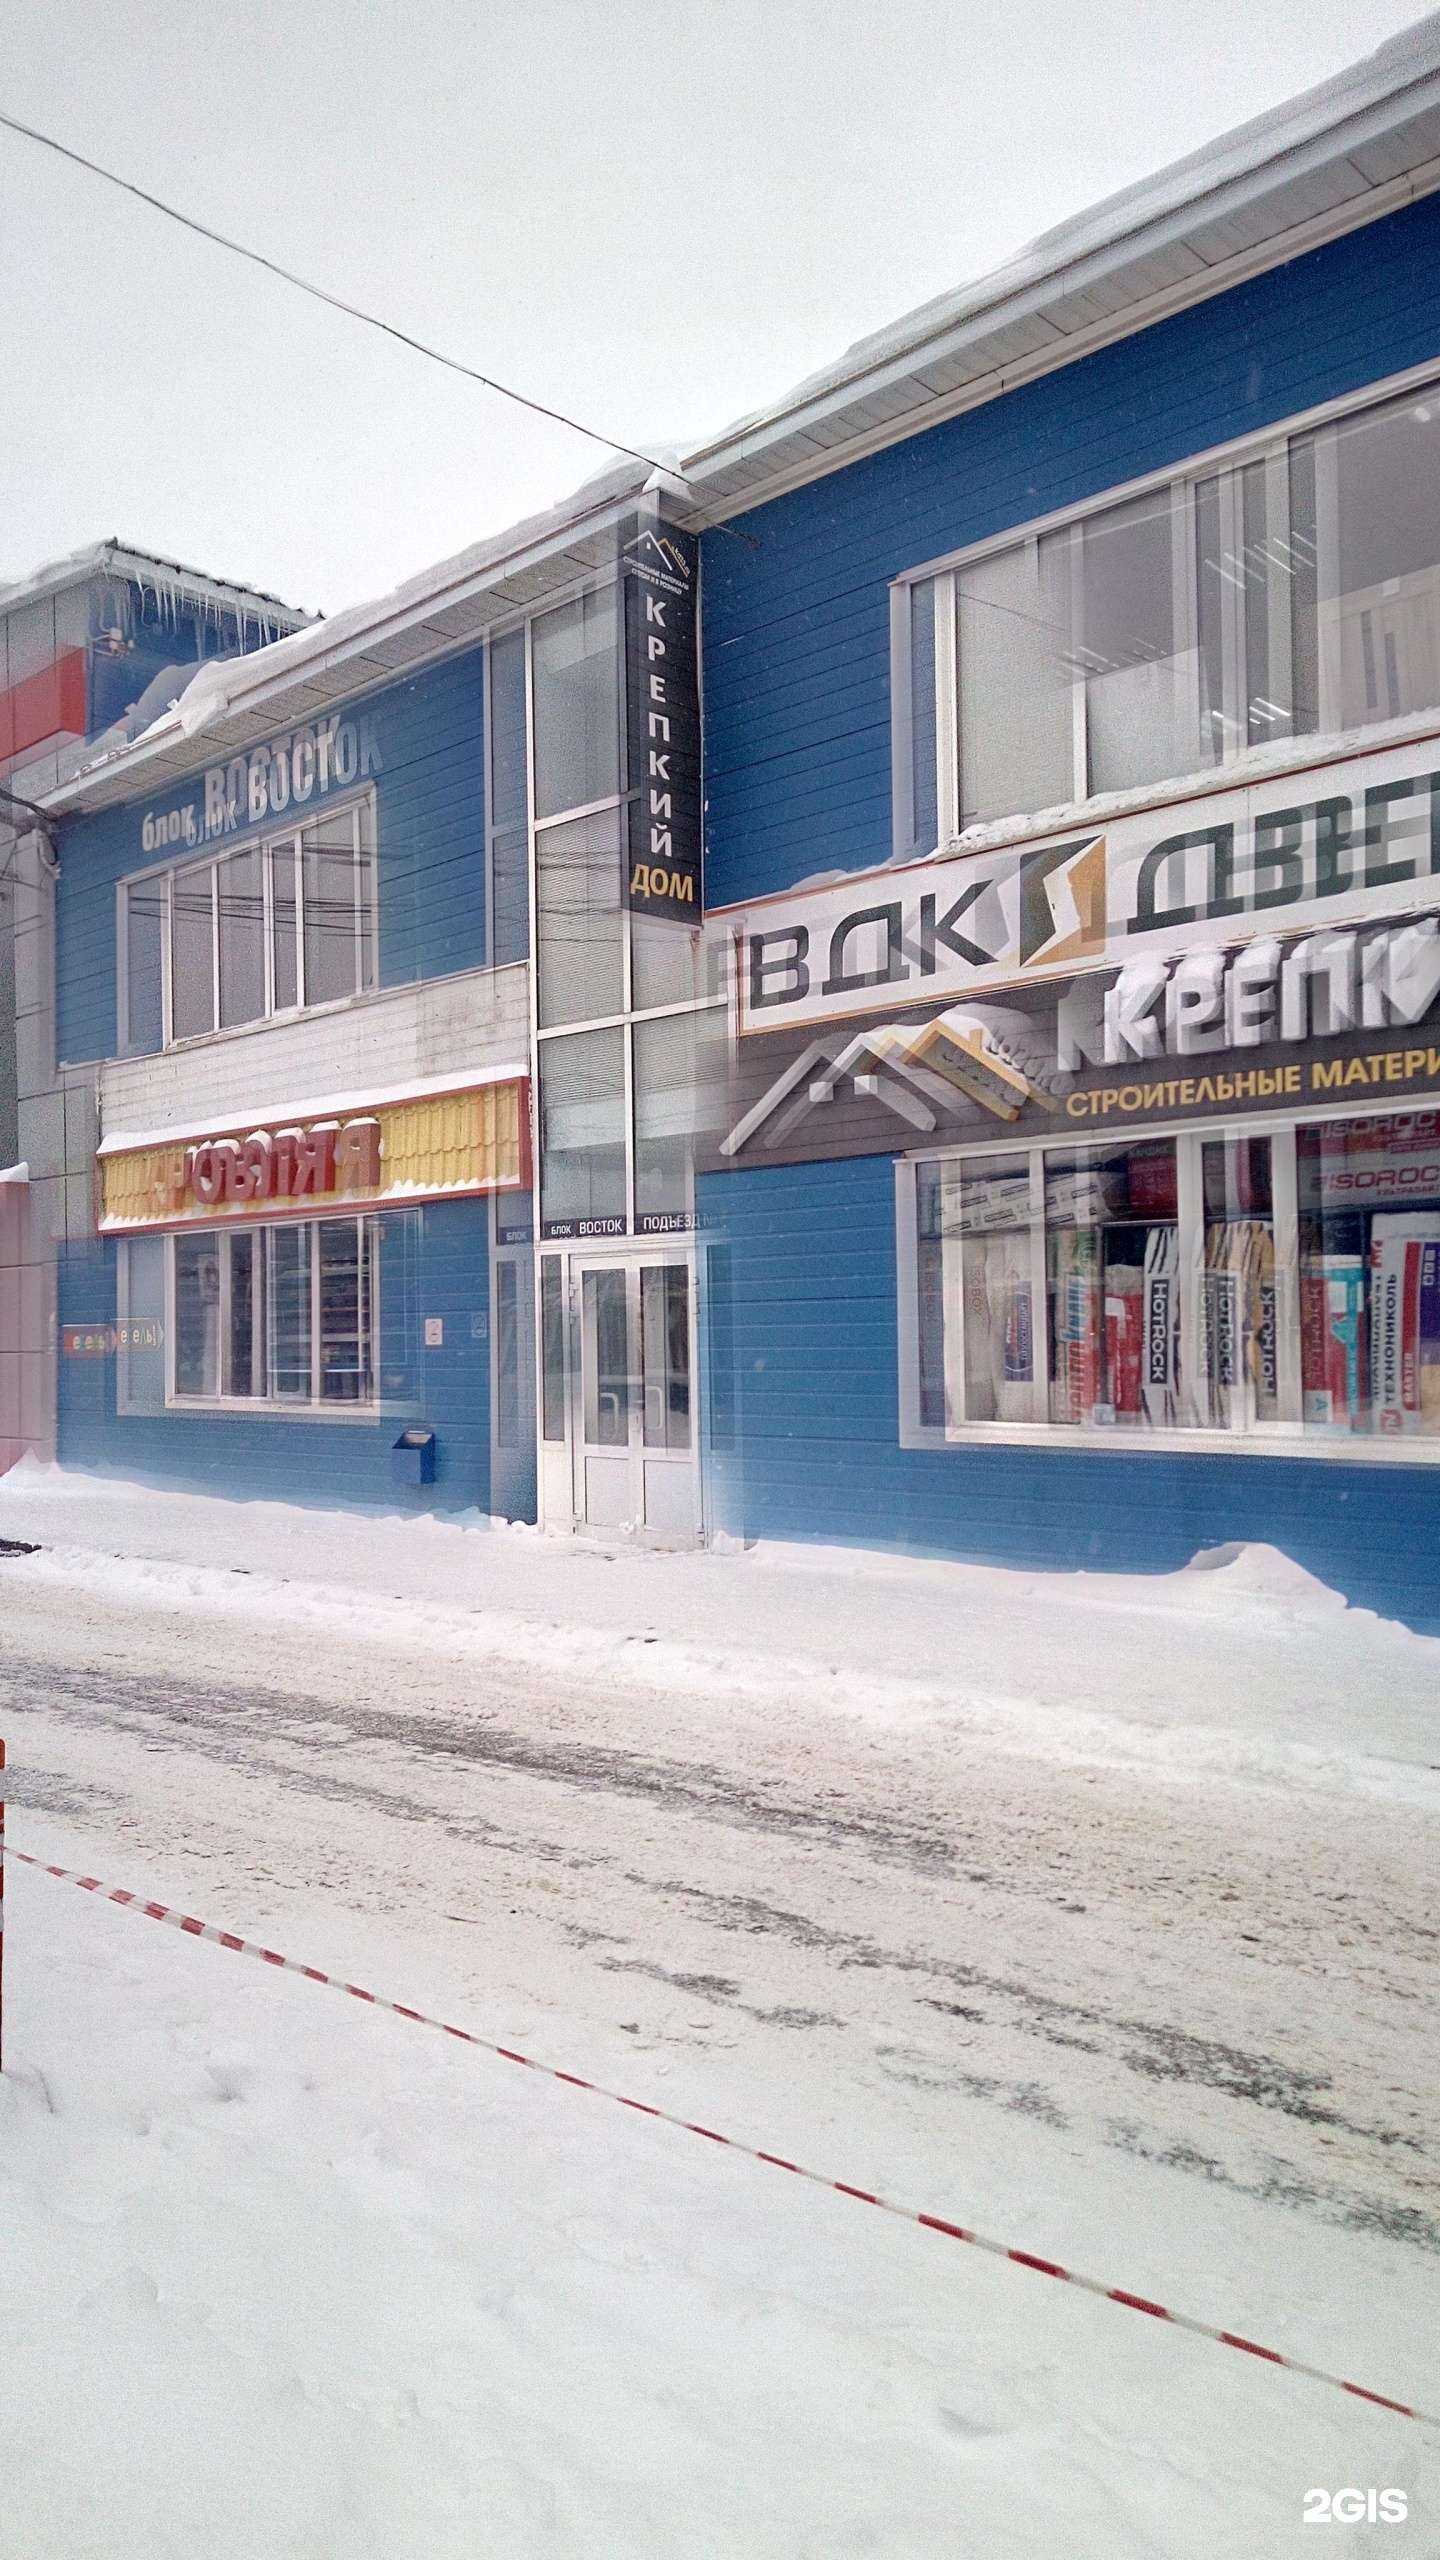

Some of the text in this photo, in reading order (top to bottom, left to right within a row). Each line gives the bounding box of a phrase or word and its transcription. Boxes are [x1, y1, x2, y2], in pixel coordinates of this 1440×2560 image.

[645, 594, 672, 858] КРЕПКИЙ
[629, 863, 694, 902] ДОМ
[750, 878, 1000, 1010] ВДК
[1066, 1065, 1301, 1117] СТРОИТЕЛЬНЫЕ
[550, 1224, 573, 1236] БЛОК
[579, 1217, 623, 1234] ВОСТОК
[643, 1213, 700, 1231] ПОДЪЕЗД
[1152, 1282, 1168, 1380] HOTROCK
[1384, 1273, 1398, 1404] ТЕХНОНИКОЛЬ
